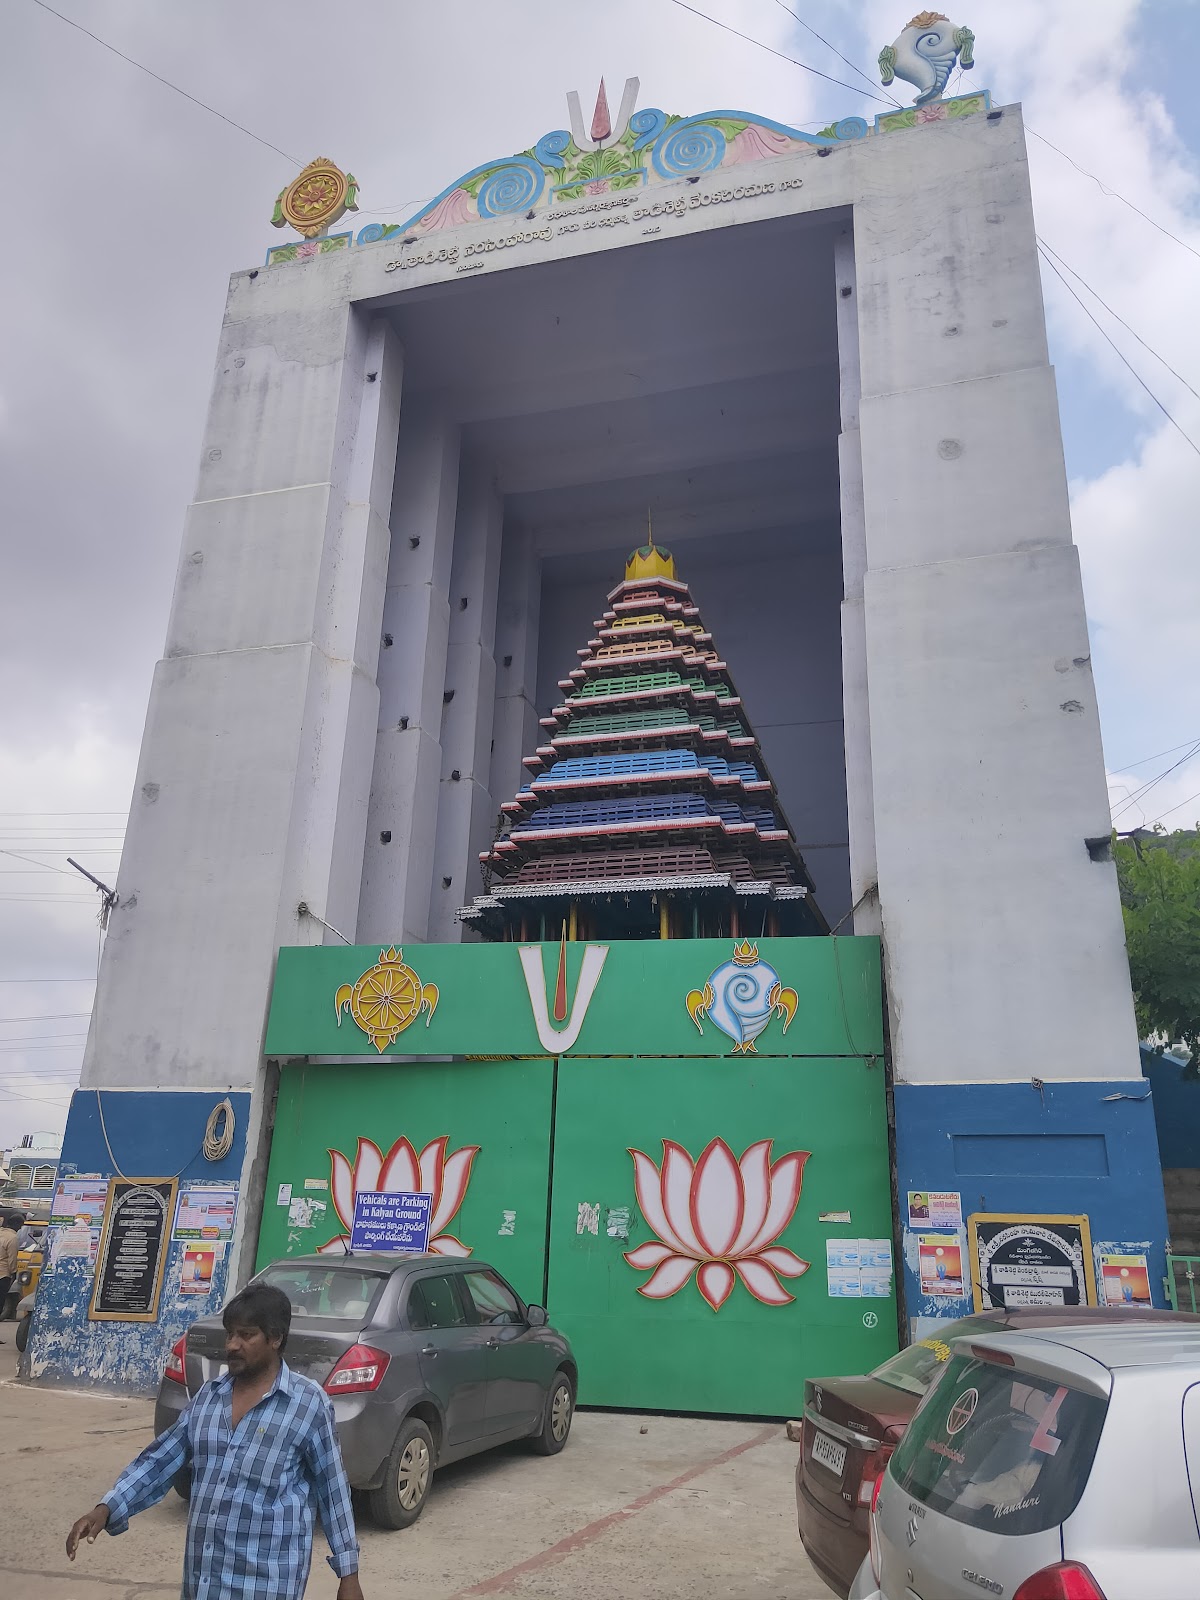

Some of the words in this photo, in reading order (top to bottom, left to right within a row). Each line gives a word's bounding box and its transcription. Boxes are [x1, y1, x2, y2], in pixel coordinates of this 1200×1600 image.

[359, 1194, 387, 1205] Vehicals
[388, 1198, 400, 1206] are
[401, 1196, 428, 1210] Parking
[362, 1207, 369, 1217] in
[371, 1207, 394, 1220] Kalyan
[395, 1208, 422, 1219] Ground
[992, 1494, 1041, 1519] Nanduri
